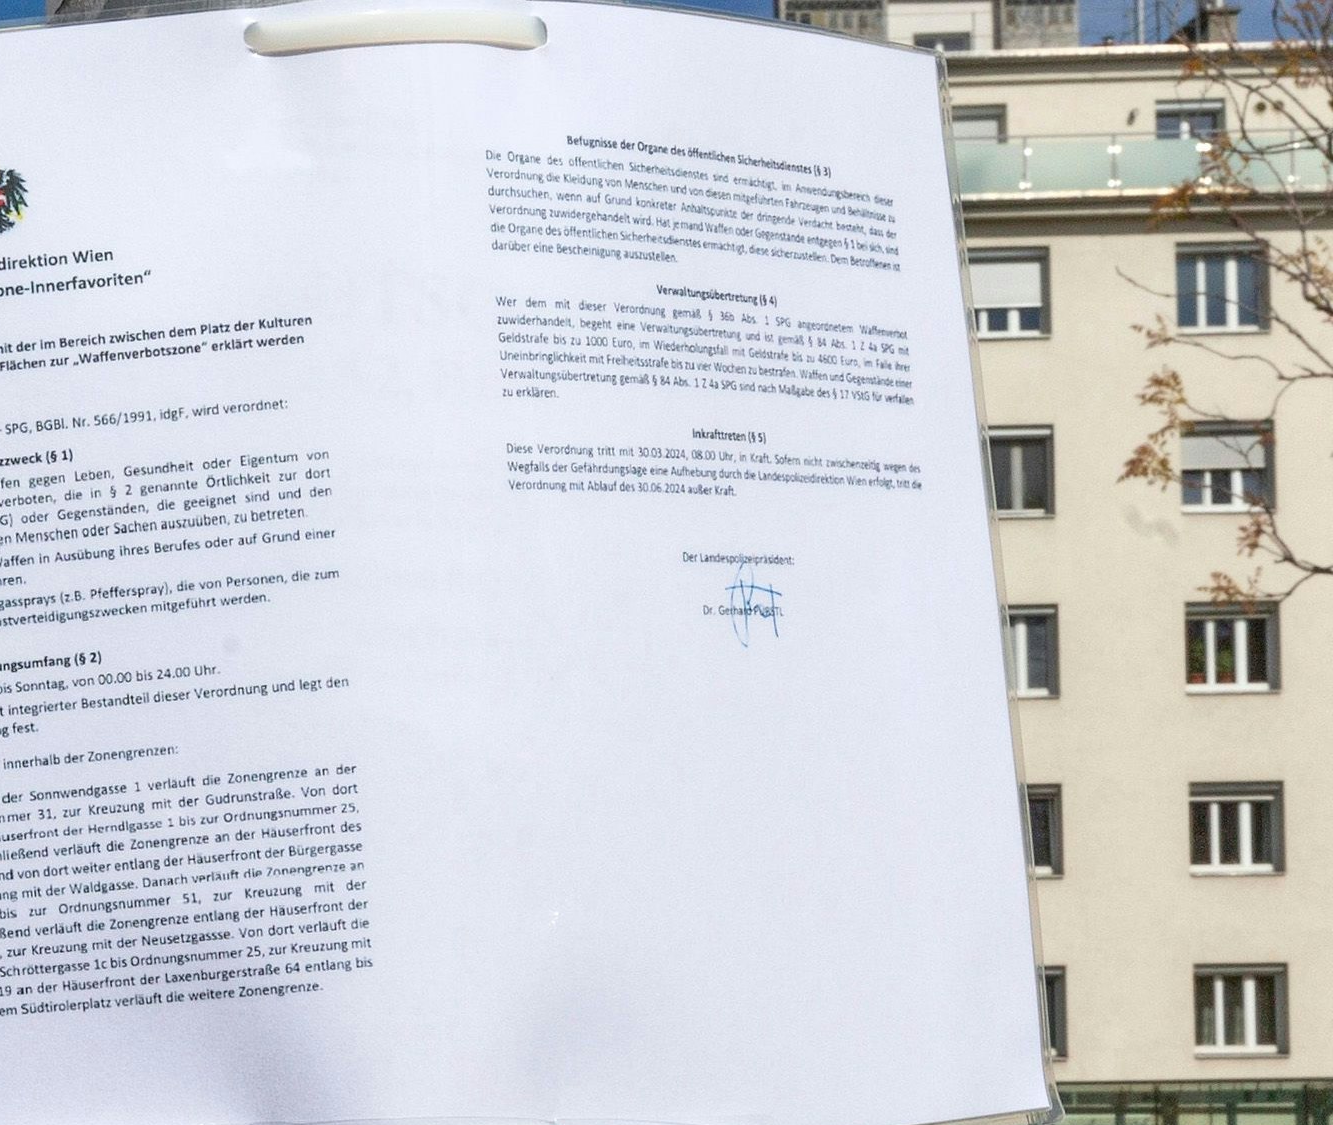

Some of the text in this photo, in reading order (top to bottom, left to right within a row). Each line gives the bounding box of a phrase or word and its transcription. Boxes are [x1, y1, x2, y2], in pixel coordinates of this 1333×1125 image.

[566, 134, 618, 149] Befugnisse
[619, 138, 636, 151] der
[636, 140, 669, 156] Organe
[669, 144, 686, 157] des
[736, 154, 813, 175] Sicherheitsdienstes
[71, 249, 114, 264] Wien
[655, 284, 758, 307] Verwaltungsübertretung
[15, 340, 37, 353] der
[39, 339, 56, 350] im
[58, 333, 106, 349] Bereich
[109, 328, 166, 344] zwischen
[168, 326, 197, 338] dem
[199, 323, 231, 335] Platz
[233, 320, 255, 332] der
[258, 316, 313, 330] Kulturen
[49, 356, 70, 367] zur
[210, 338, 253, 352] erklärt
[255, 333, 305, 348] werden
[4, 421, 32, 435] SPG,
[71, 416, 90, 429] Nr.
[191, 403, 220, 417] wird
[222, 398, 288, 414] verordnet:
[691, 427, 747, 442] Inkrafttreten
[28, 474, 66, 489] gegen
[122, 461, 194, 477] Gesundheit
[201, 457, 232, 470] oder
[239, 453, 299, 468] Eigentum
[306, 451, 329, 461] von
[508, 479, 737, 497] Verordnung mit Ablauf des 30.06.2024 außer Kraft.
[682, 550, 698, 563] Der
[20, 997, 112, 1015] Südtirolerplatz
[114, 991, 163, 1007] verläuft
[165, 990, 185, 1003] die
[187, 988, 235, 1002] weitere
[237, 982, 323, 998] Zonengrenze.
